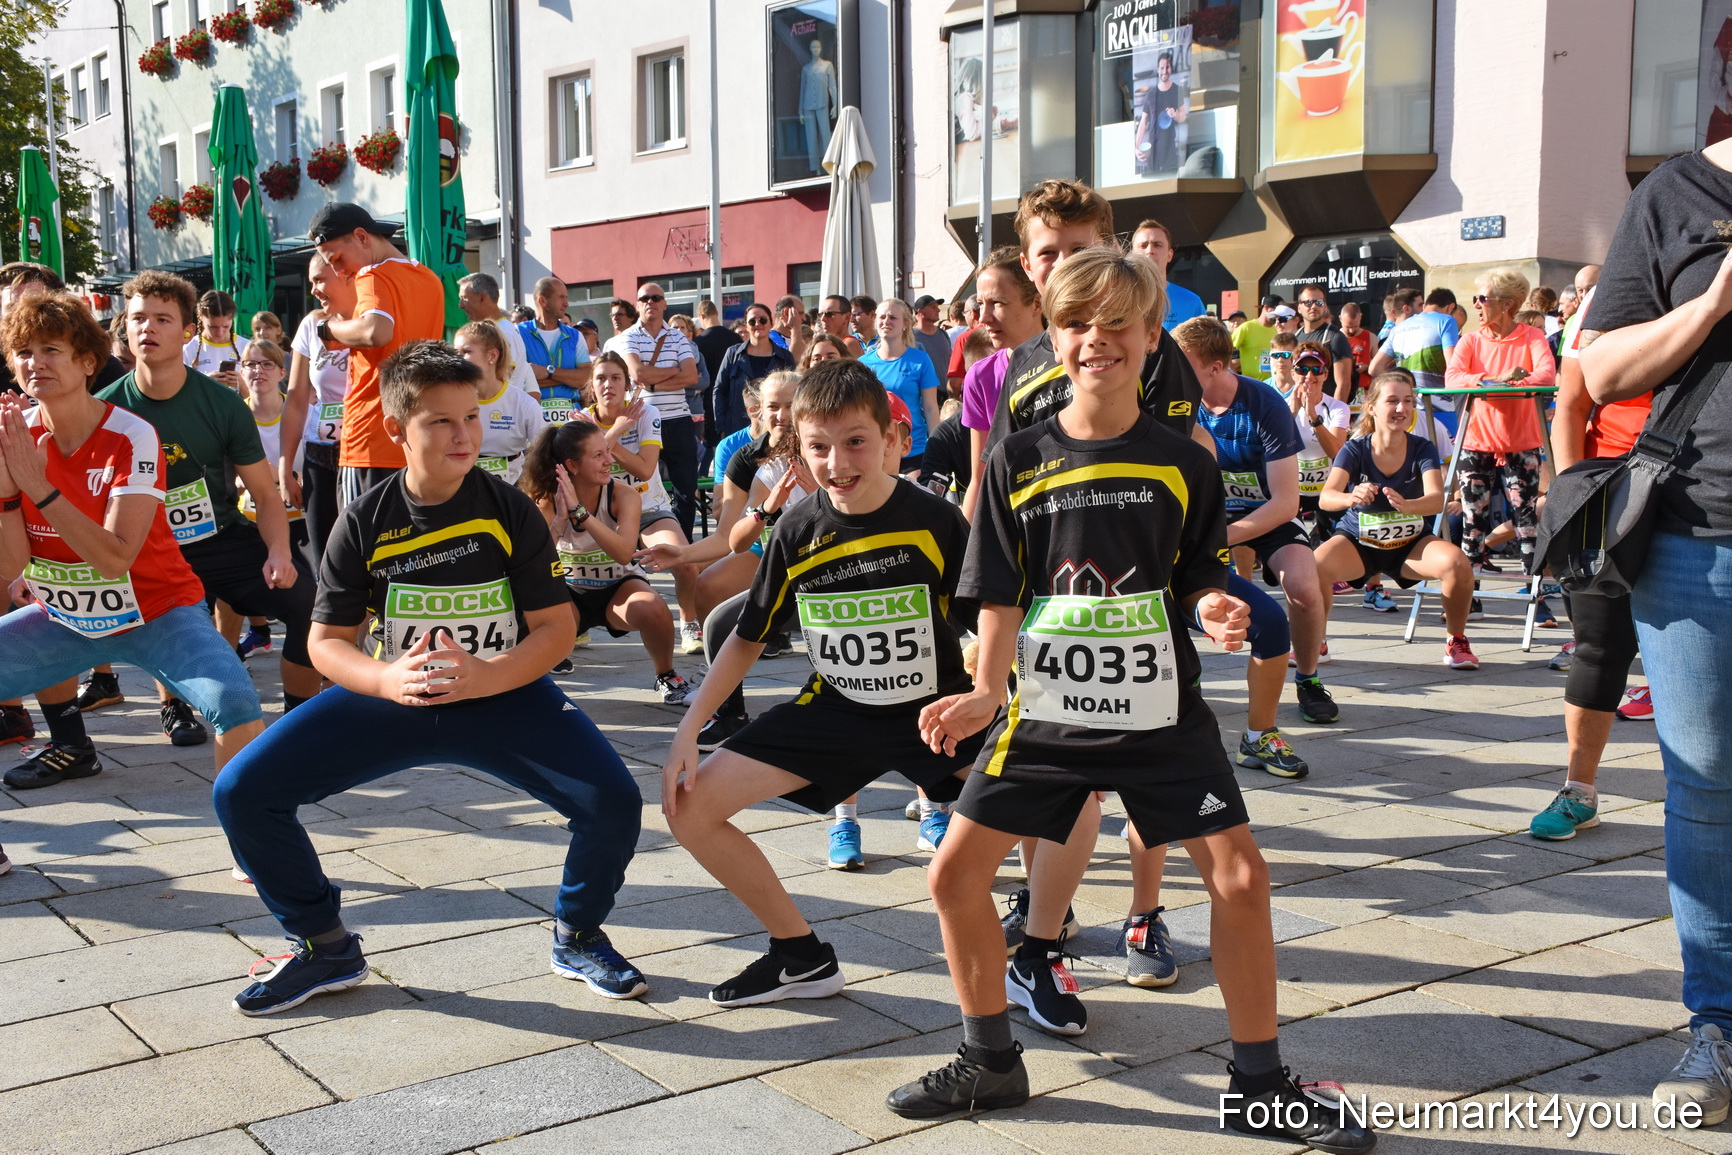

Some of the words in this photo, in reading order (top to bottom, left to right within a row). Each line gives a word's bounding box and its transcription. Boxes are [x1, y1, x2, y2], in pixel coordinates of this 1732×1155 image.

[1112, 2, 1132, 19] 100
[1107, 14, 1158, 51] RACKL
[1274, 277, 1316, 286] Willkommen
[1317, 275, 1327, 283] im
[1328, 266, 1368, 289] RACKL
[1369, 269, 1419, 279] Erlebnishaus.
[1016, 361, 1048, 386] saller
[541, 400, 570, 408] BOCK
[1016, 457, 1065, 484] saller
[1298, 471, 1325, 483] 042
[164, 486, 200, 504] CK
[1020, 486, 1154, 524] www.mk-abdichtungen.de
[169, 504, 203, 526] 05
[798, 531, 837, 557] saller
[1367, 525, 1416, 540] 5223
[563, 566, 613, 578] 2111
[800, 550, 911, 593] www.mk-abdichtungen.de
[38, 586, 124, 612] 2070
[397, 587, 506, 613] BOCK
[807, 594, 916, 622] BOCK
[1034, 600, 1157, 631] BOCK
[819, 627, 919, 667] 4035
[1034, 642, 1159, 685] 4033
[826, 671, 924, 692] DOMENICO
[1063, 695, 1131, 714] NOAH
[1198, 801, 1227, 816] adidas
